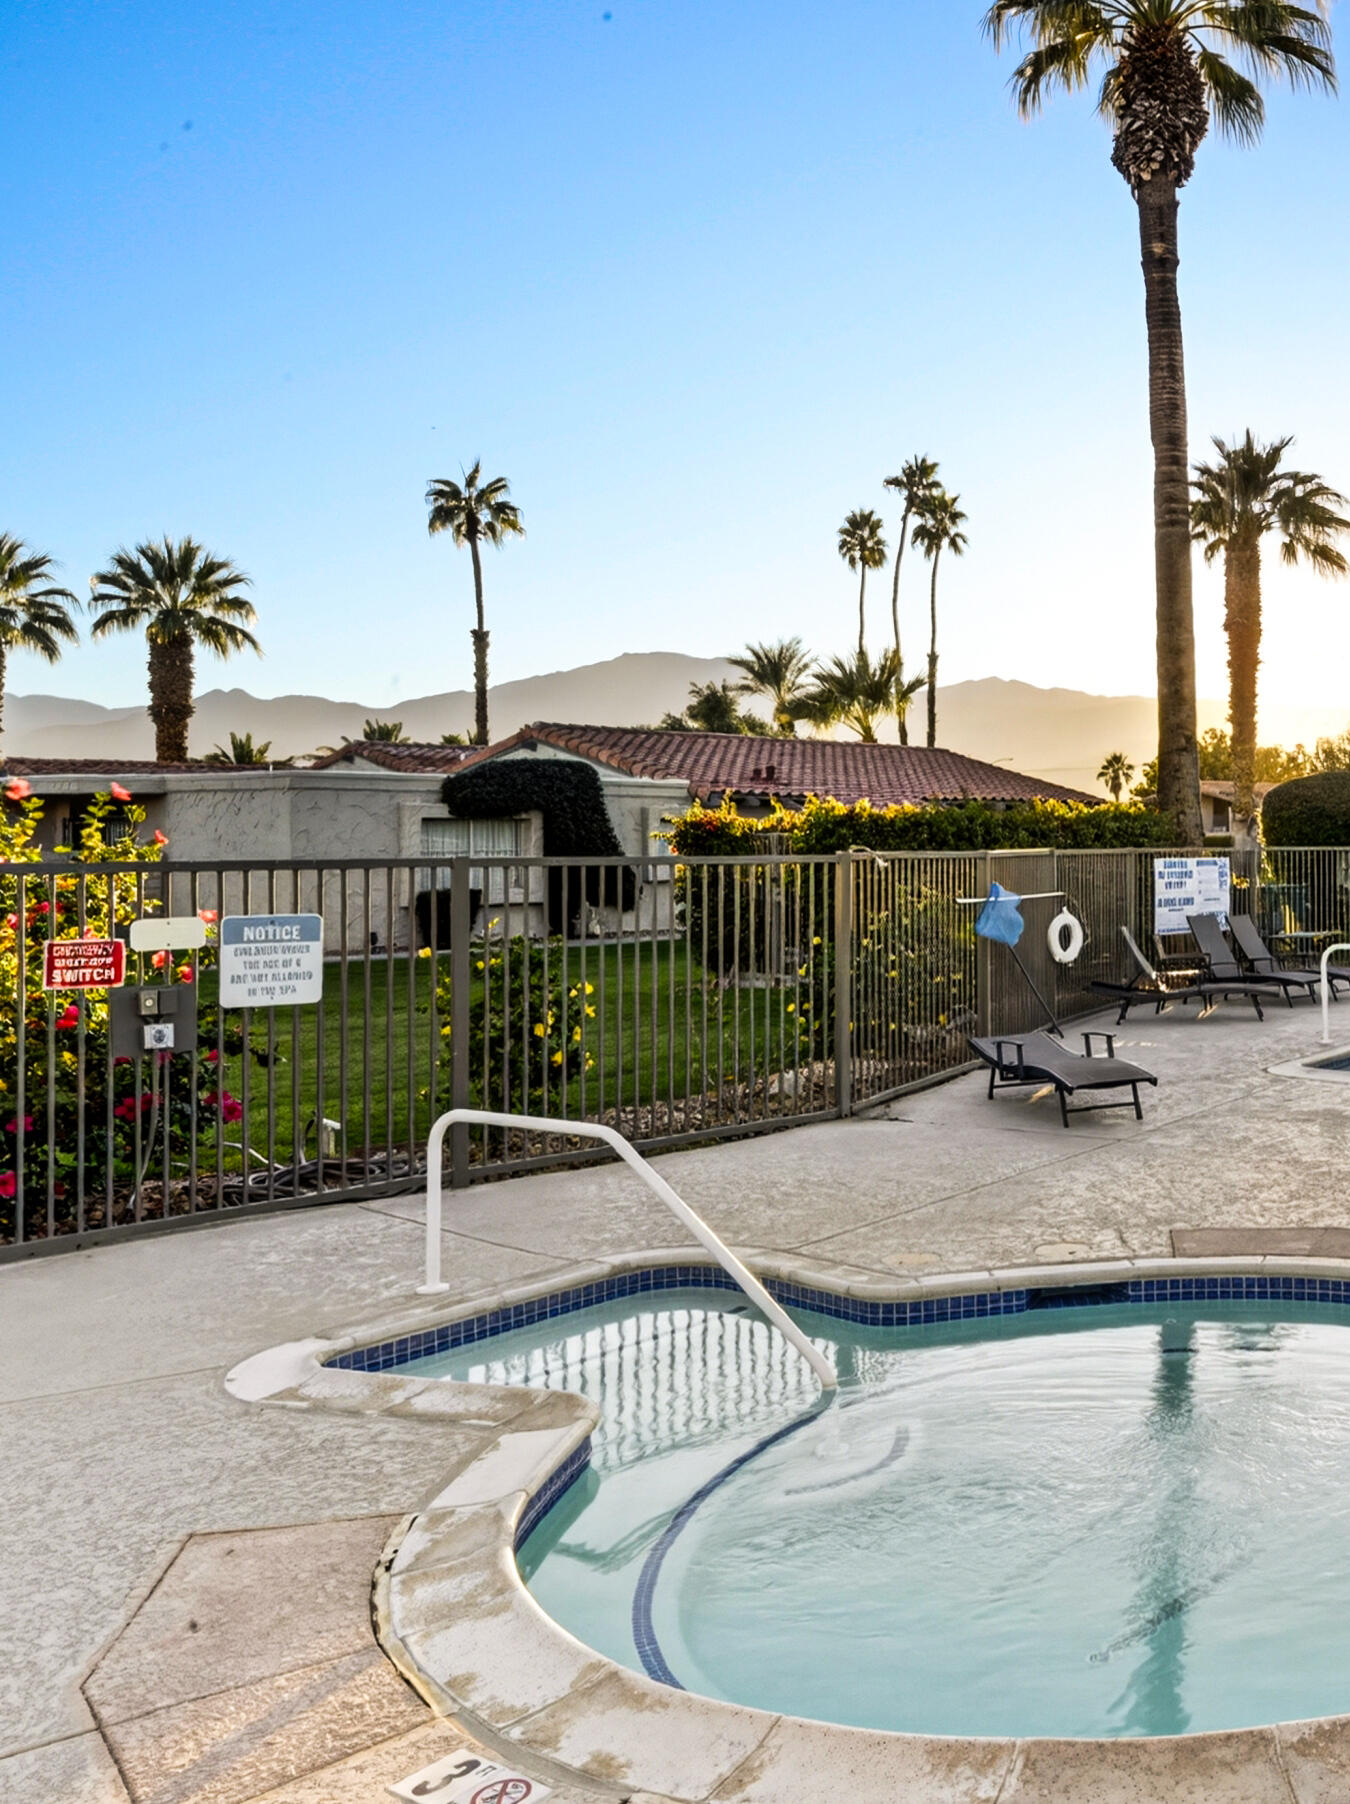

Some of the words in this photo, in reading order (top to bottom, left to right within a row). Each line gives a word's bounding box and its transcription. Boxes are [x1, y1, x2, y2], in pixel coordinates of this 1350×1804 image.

[243, 925, 301, 941] NOTICE
[51, 967, 115, 983] SWITCH
[411, 1759, 482, 1796] 3
